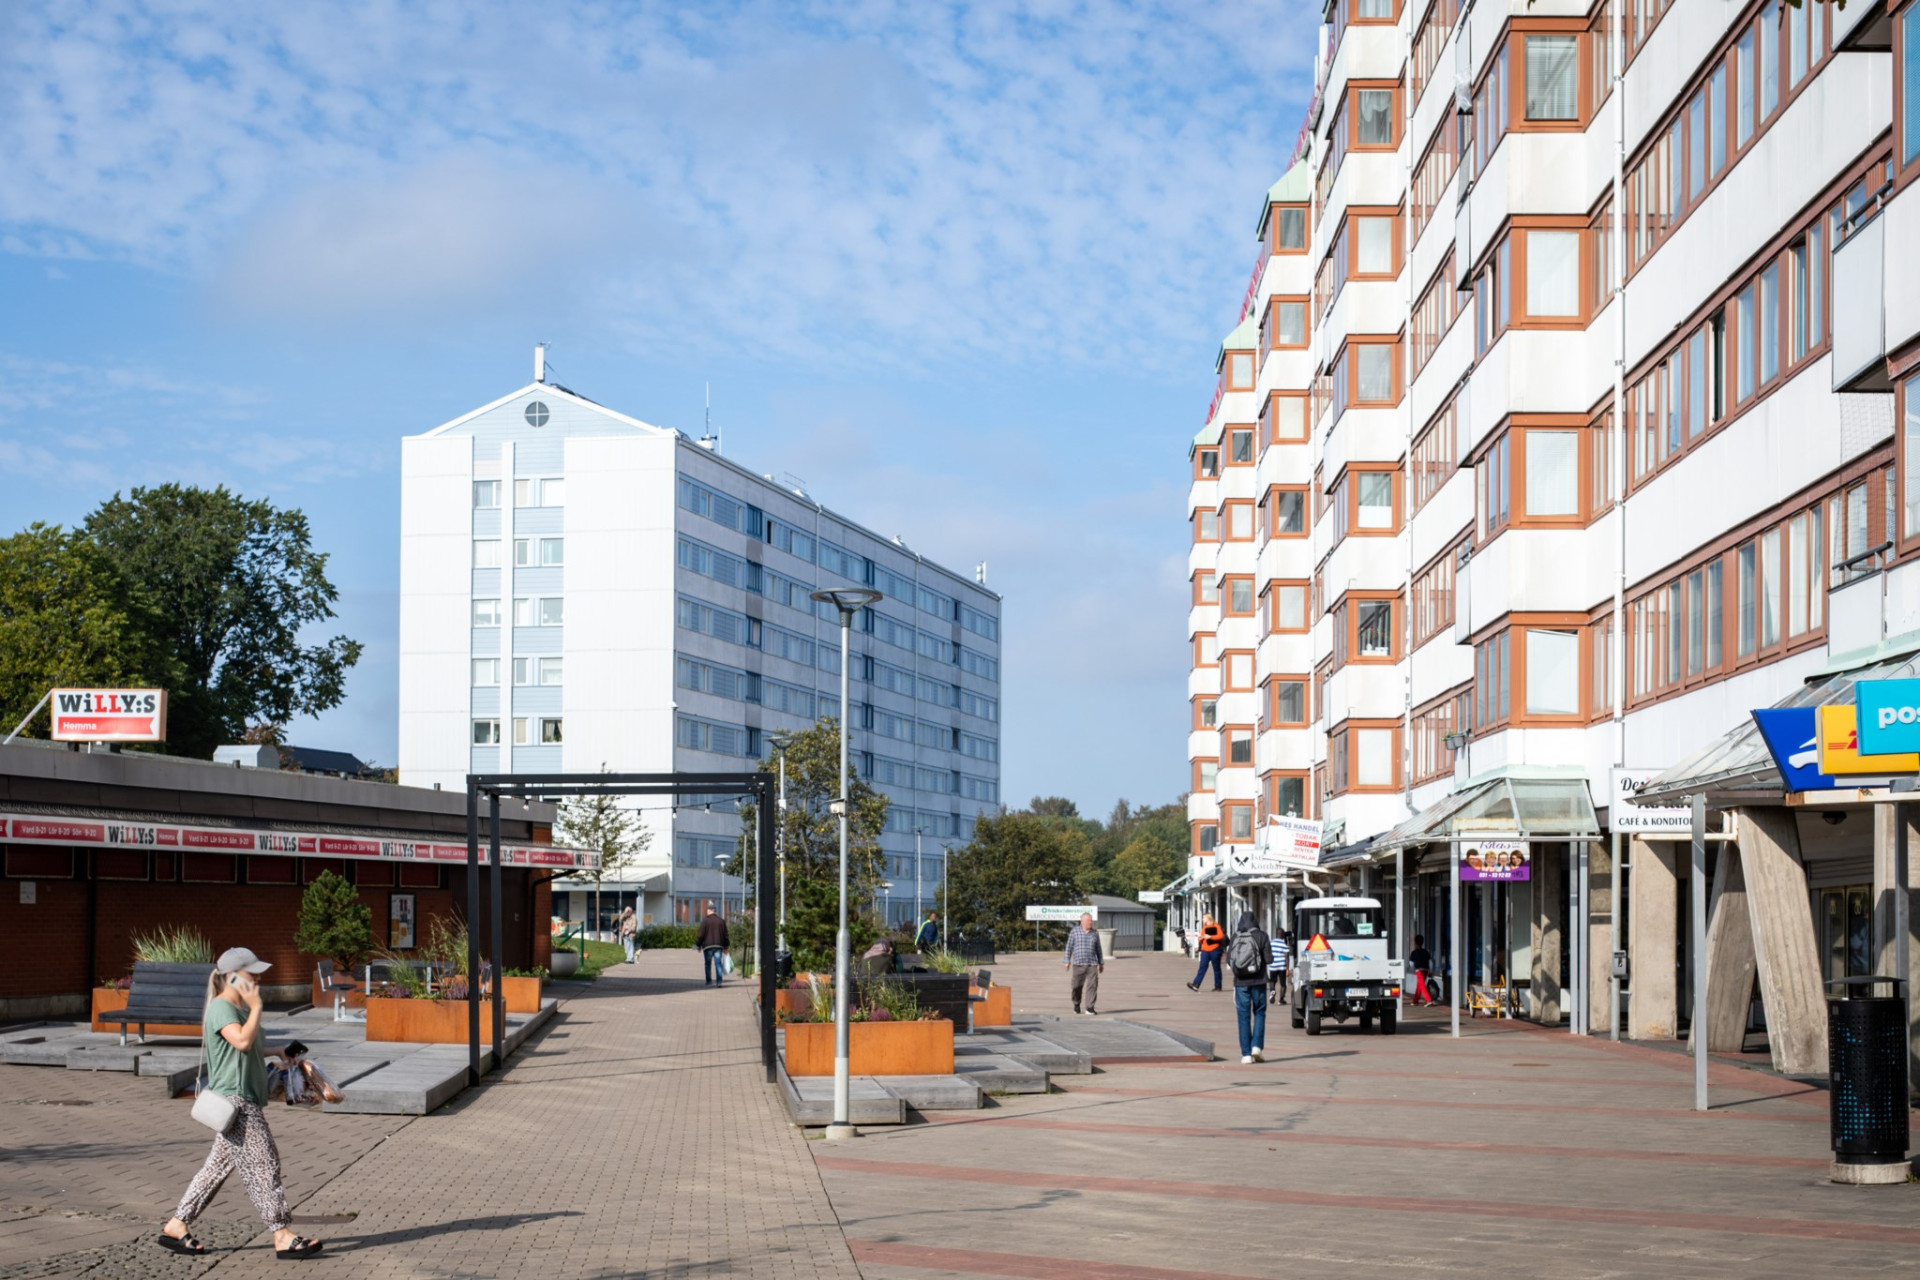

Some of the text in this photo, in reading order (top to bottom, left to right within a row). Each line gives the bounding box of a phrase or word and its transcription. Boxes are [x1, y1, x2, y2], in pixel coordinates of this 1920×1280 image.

[63, 722, 97, 730] Hemma
[1618, 815, 1639, 826] CAFÉ
[1642, 817, 1649, 826] &
